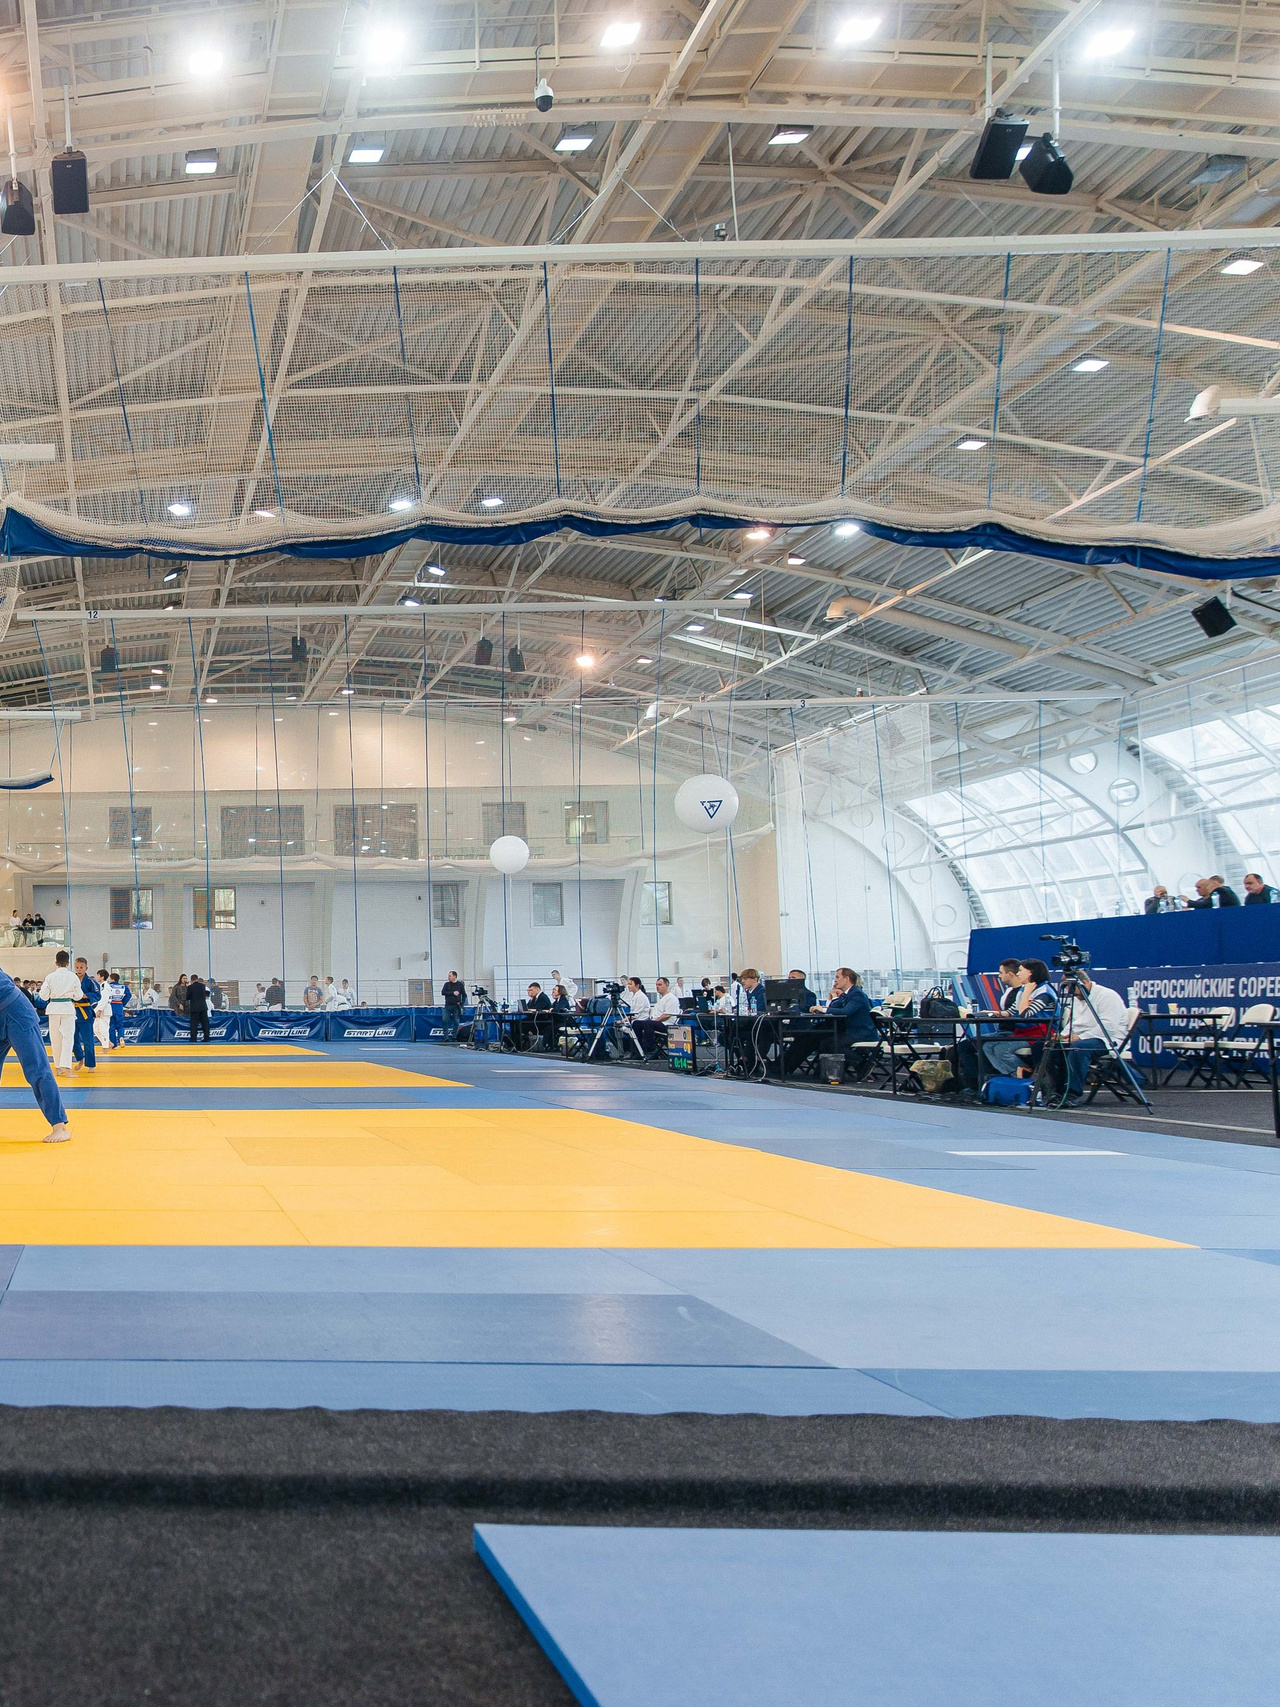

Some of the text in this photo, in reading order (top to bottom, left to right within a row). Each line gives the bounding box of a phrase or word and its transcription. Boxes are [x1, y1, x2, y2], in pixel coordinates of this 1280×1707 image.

[87, 610, 98, 619] 12
[800, 699, 806, 708] 3
[1133, 974, 1235, 999] ВСЕРОССИЙСКИЕ
